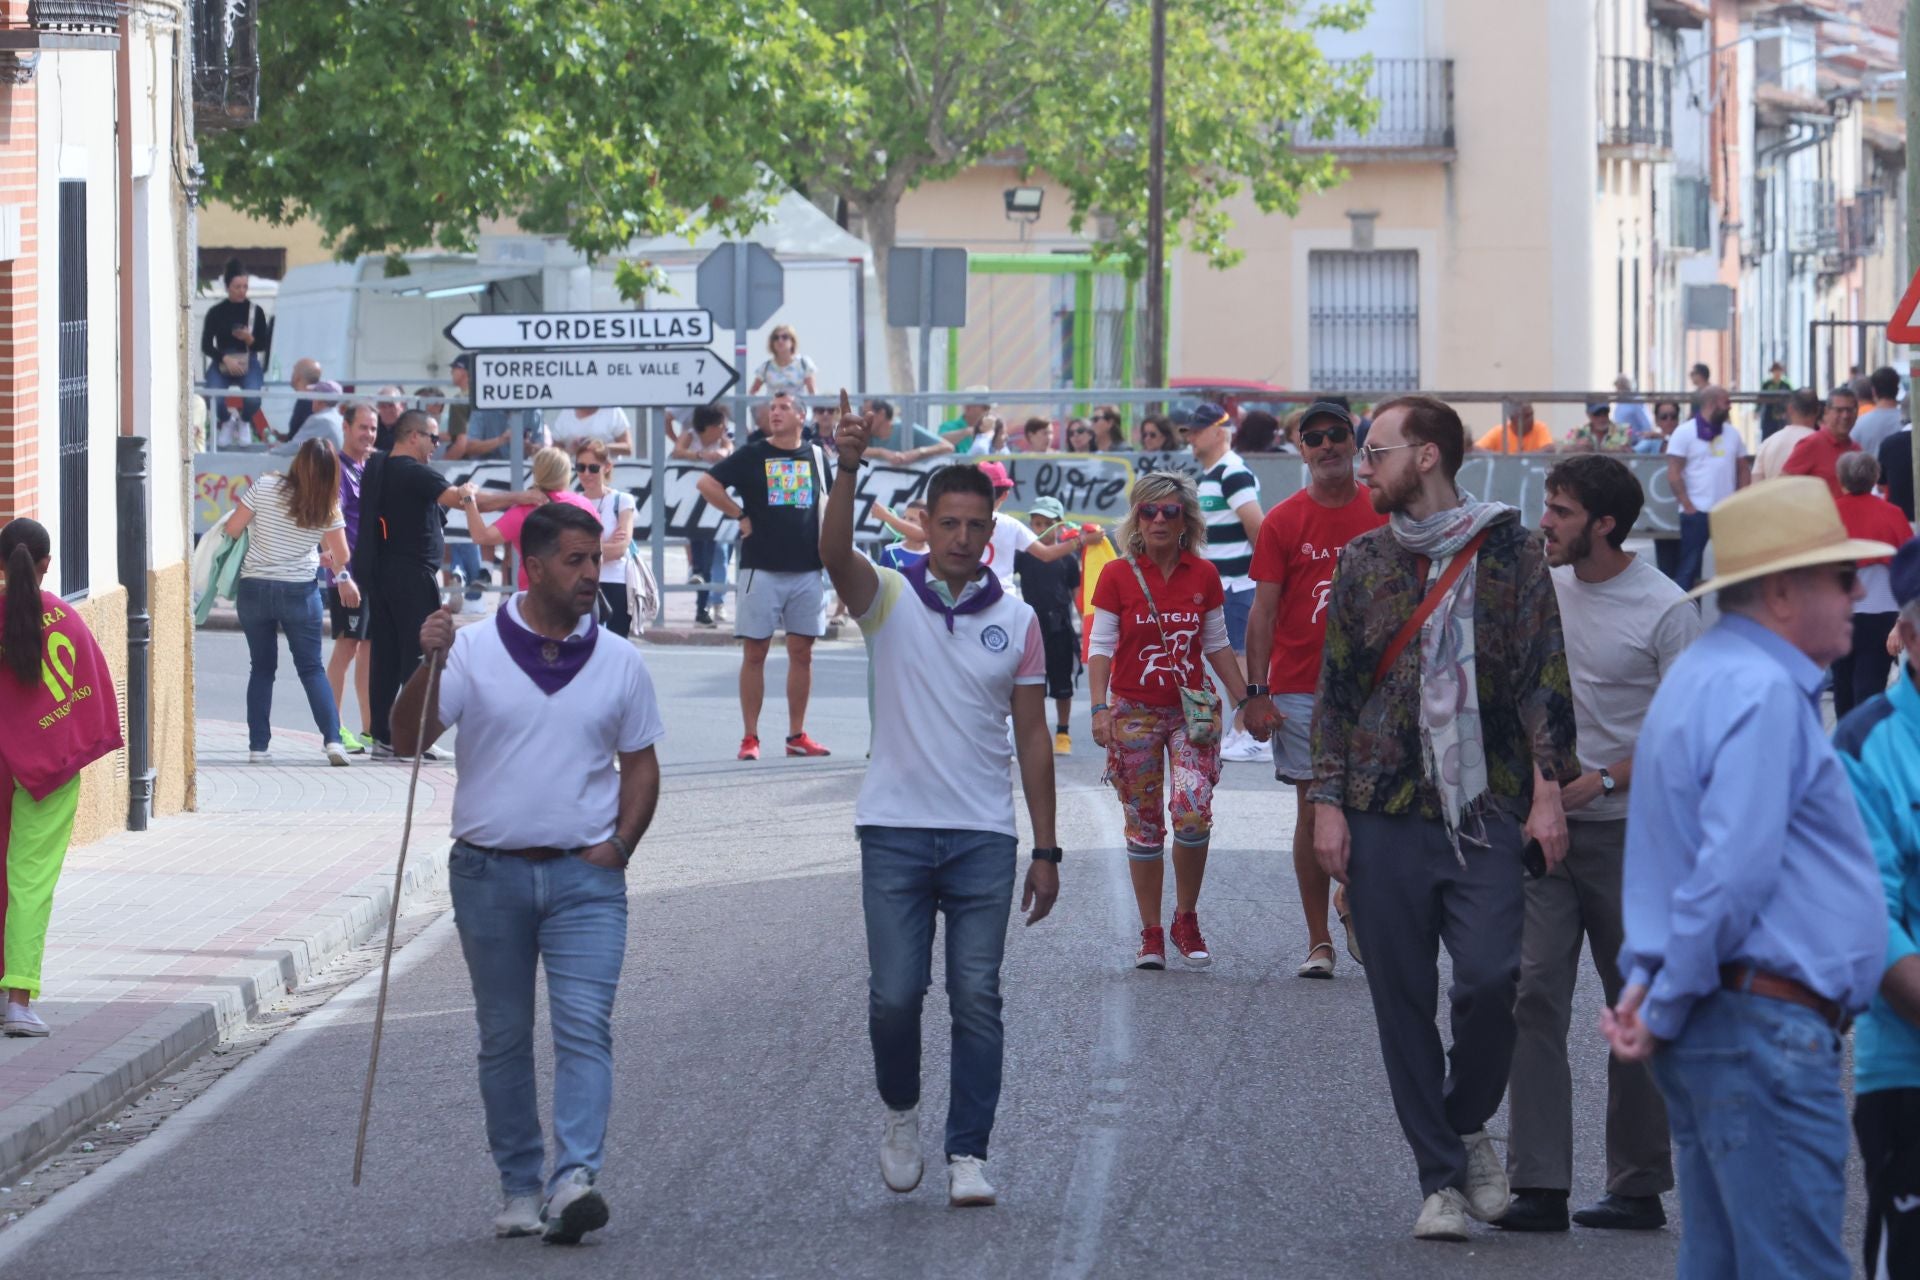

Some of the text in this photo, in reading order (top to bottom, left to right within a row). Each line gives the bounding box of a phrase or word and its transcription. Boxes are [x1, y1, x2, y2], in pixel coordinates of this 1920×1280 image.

[517, 317, 703, 341] TORDESILLAS
[482, 359, 705, 378] TORRECILLA DEL VALLE 7
[482, 381, 705, 401] RUEDA 14
[1311, 547, 1330, 560] LA
[1136, 612, 1200, 625] LA TEJA
[38, 713, 55, 729] SIN
